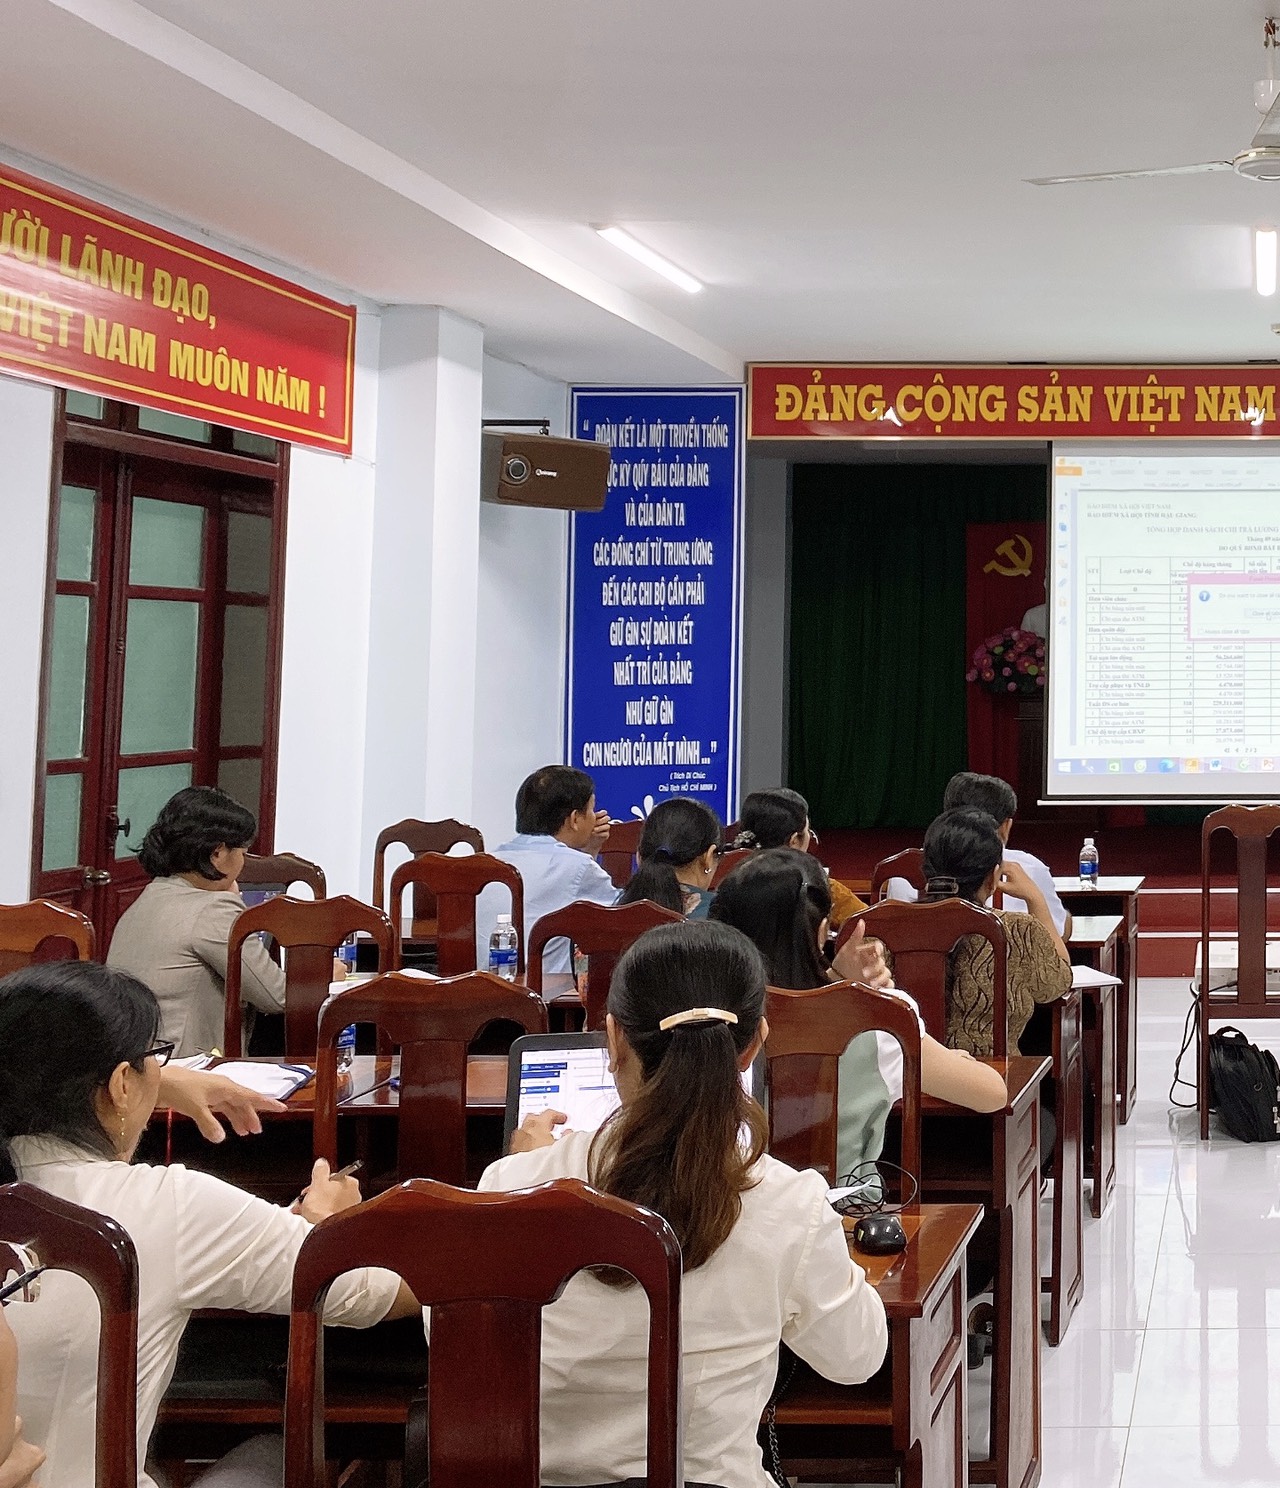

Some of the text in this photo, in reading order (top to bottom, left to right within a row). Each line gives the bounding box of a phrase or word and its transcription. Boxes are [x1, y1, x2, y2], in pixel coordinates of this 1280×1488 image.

[59, 235, 144, 299] LÃNH
[153, 267, 216, 330] ĐẠO,
[83, 314, 156, 372] NAM
[169, 339, 249, 397] MUÔN
[256, 365, 310, 415] NĂM
[775, 370, 885, 422] ĐẢNG
[899, 374, 1006, 433] CỘNG
[1017, 371, 1093, 422] SẢN
[1104, 374, 1186, 432] VIỆT
[1195, 385, 1276, 421] NAM
[619, 416, 634, 447] KẾT
[637, 419, 646, 447] LÀ
[650, 419, 666, 452] MỘT
[669, 416, 699, 447] TRUYỀN
[702, 416, 728, 447] THỐNG
[619, 455, 709, 490] KỲ QUÝ BÁU CỦA ĐẢNG
[625, 494, 685, 526] VÀ CỦA DÂN TA
[594, 537, 611, 566] CÁC
[612, 535, 634, 566] ĐỒNG
[635, 537, 649, 566] CHÍ
[650, 536, 662, 566] TỪ
[663, 542, 690, 566] TRUNG
[602, 573, 705, 610] ĐẾN CÁC CHI BỘ CẦN PHẢI
[610, 614, 694, 650] GIỮ GÌN SỰ ĐOÀN KẾT
[614, 652, 692, 685] NHẤT TRÍ CỦA ĐẢNG
[626, 695, 673, 725] NHƯ GIỮ GÌN
[583, 742, 602, 766] CON
[634, 733, 652, 766] CỦA
[653, 732, 674, 765] MẮT
[675, 736, 700, 765] MÌNH
